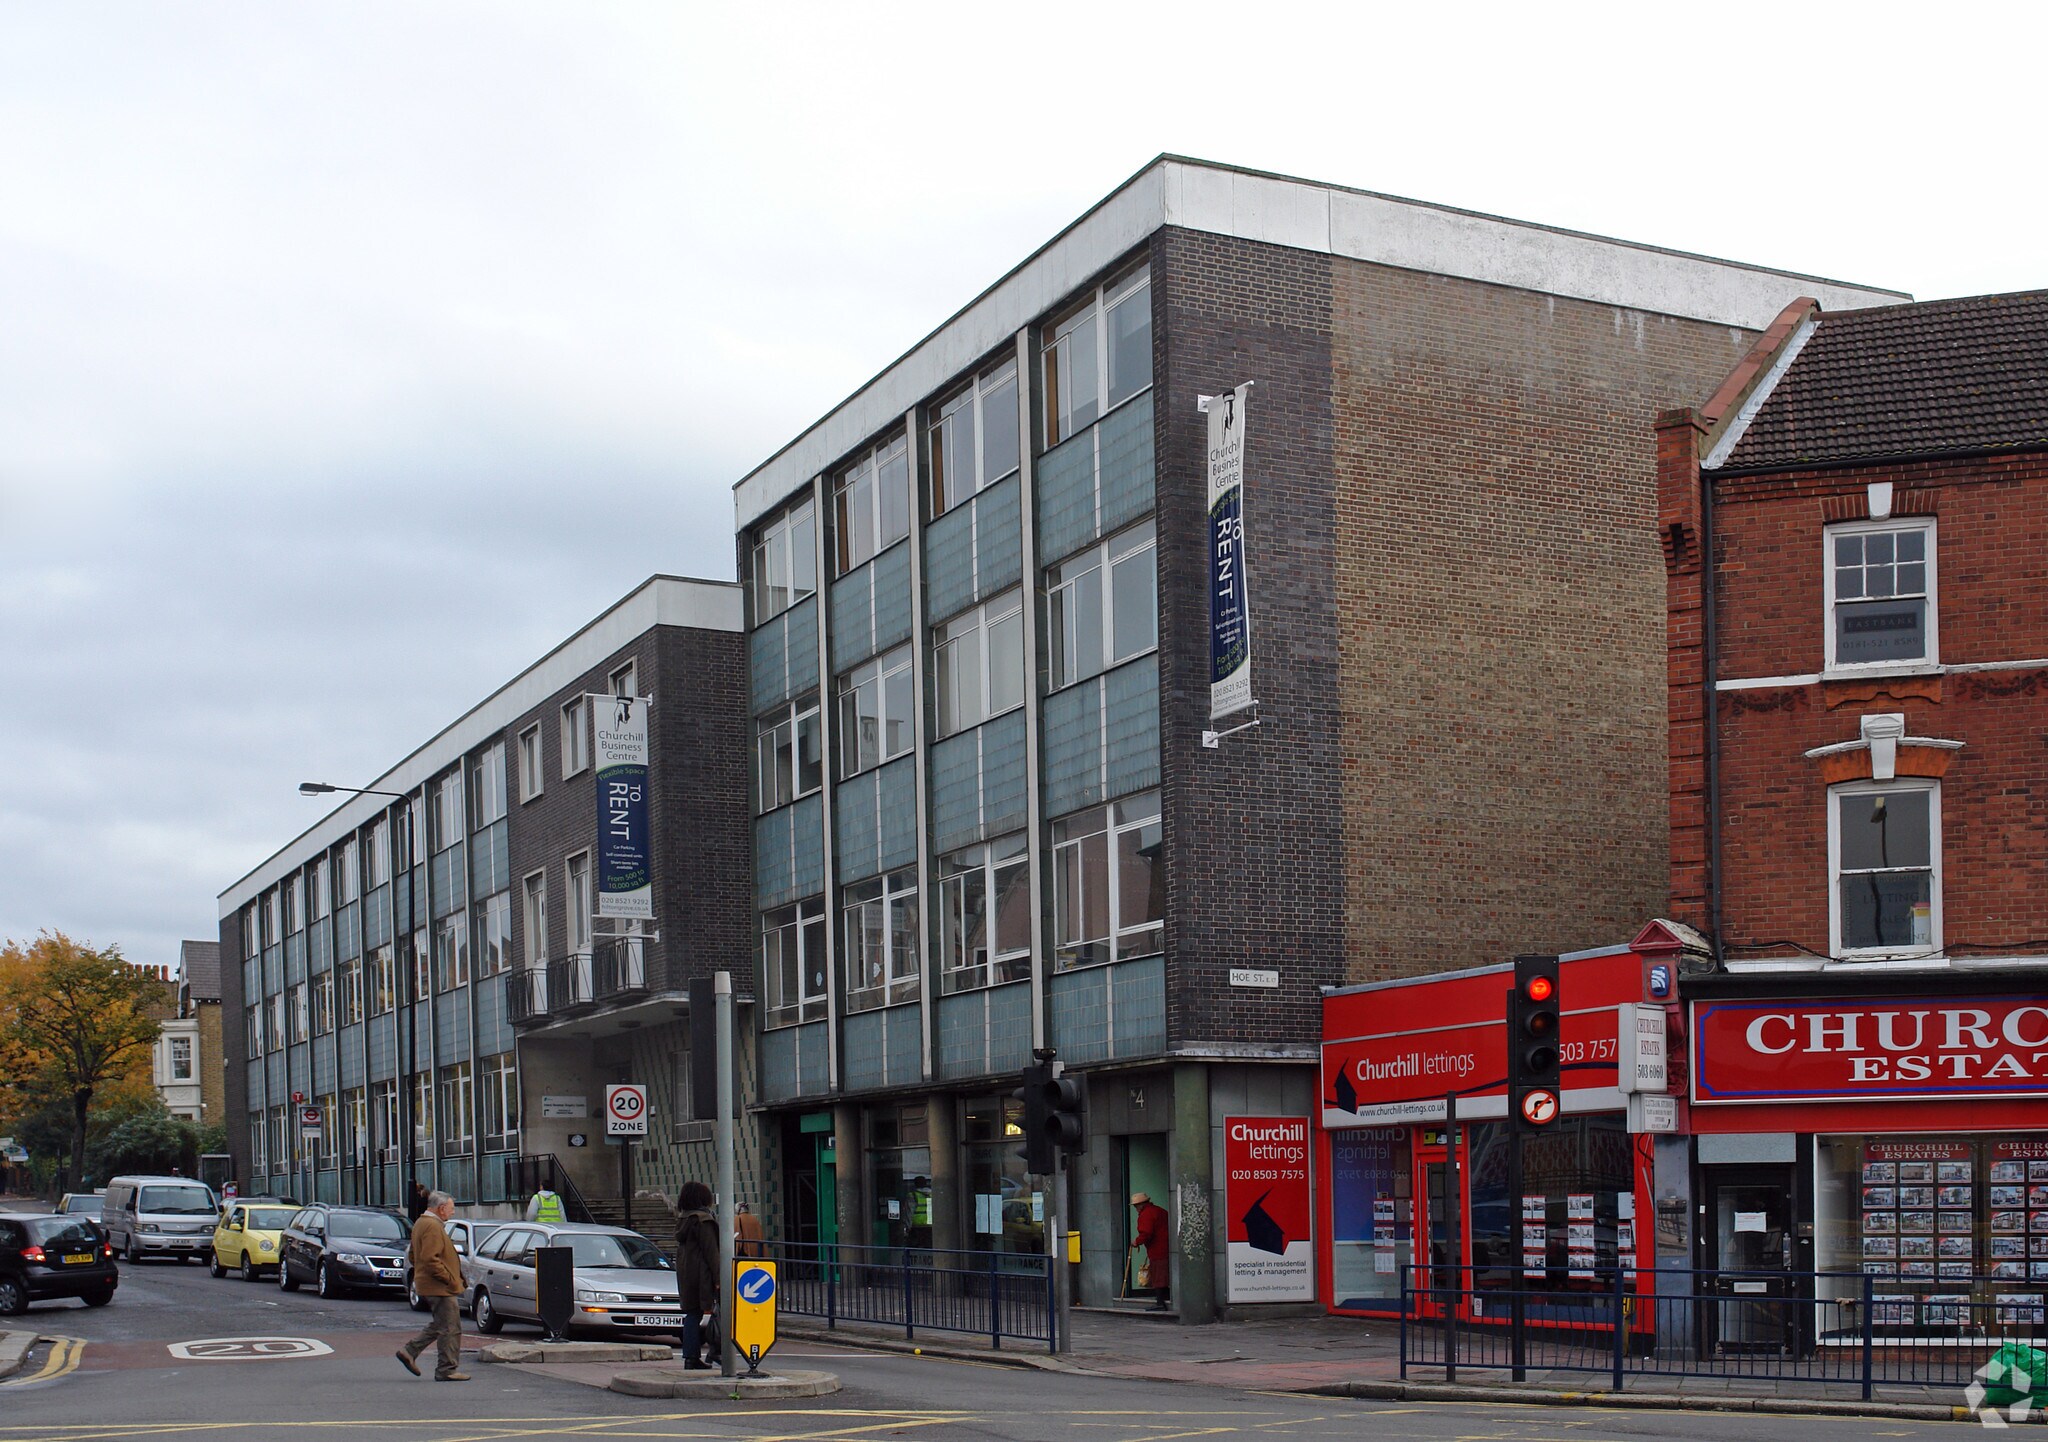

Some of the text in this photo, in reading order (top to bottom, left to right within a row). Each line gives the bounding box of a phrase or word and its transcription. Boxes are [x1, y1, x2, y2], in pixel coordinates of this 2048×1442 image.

[1232, 514, 1241, 540] TO
[1217, 517, 1233, 600] RENT
[598, 730, 643, 741] Churchill
[601, 741, 642, 751] Business
[606, 751, 637, 761] Centre
[630, 784, 641, 802] TO
[609, 782, 629, 840] RENT
[625, 872, 637, 881] 500
[1232, 973, 1250, 982] HOE
[1254, 974, 1264, 982] ST.
[1637, 1018, 1663, 1034] CHURCHILL
[1641, 1040, 1660, 1055] ESTATES
[1356, 1050, 1475, 1081] Churchill lettings
[1637, 1064, 1664, 1079] 503 6060
[616, 1097, 639, 1110] 20
[1135, 1088, 1144, 1108] 4
[1359, 1102, 1446, 1117] www.churchill-lettings.co.uk
[612, 1122, 643, 1131] ZONE
[1231, 1124, 1304, 1141] Churchill
[1250, 1142, 1304, 1164] lettings
[1870, 1144, 1964, 1152] CHURCHILL
[1884, 1151, 1951, 1159] ESTATES
[1232, 1170, 1304, 1180] 020 8503 7575
[1234, 1261, 1265, 1269] specialist
[1234, 1269, 1255, 1277] letting
[1264, 1268, 1307, 1276] management
[636, 1316, 682, 1325] L503 HHM
[190, 1342, 310, 1355] 20
[752, 1345, 758, 1353] B
